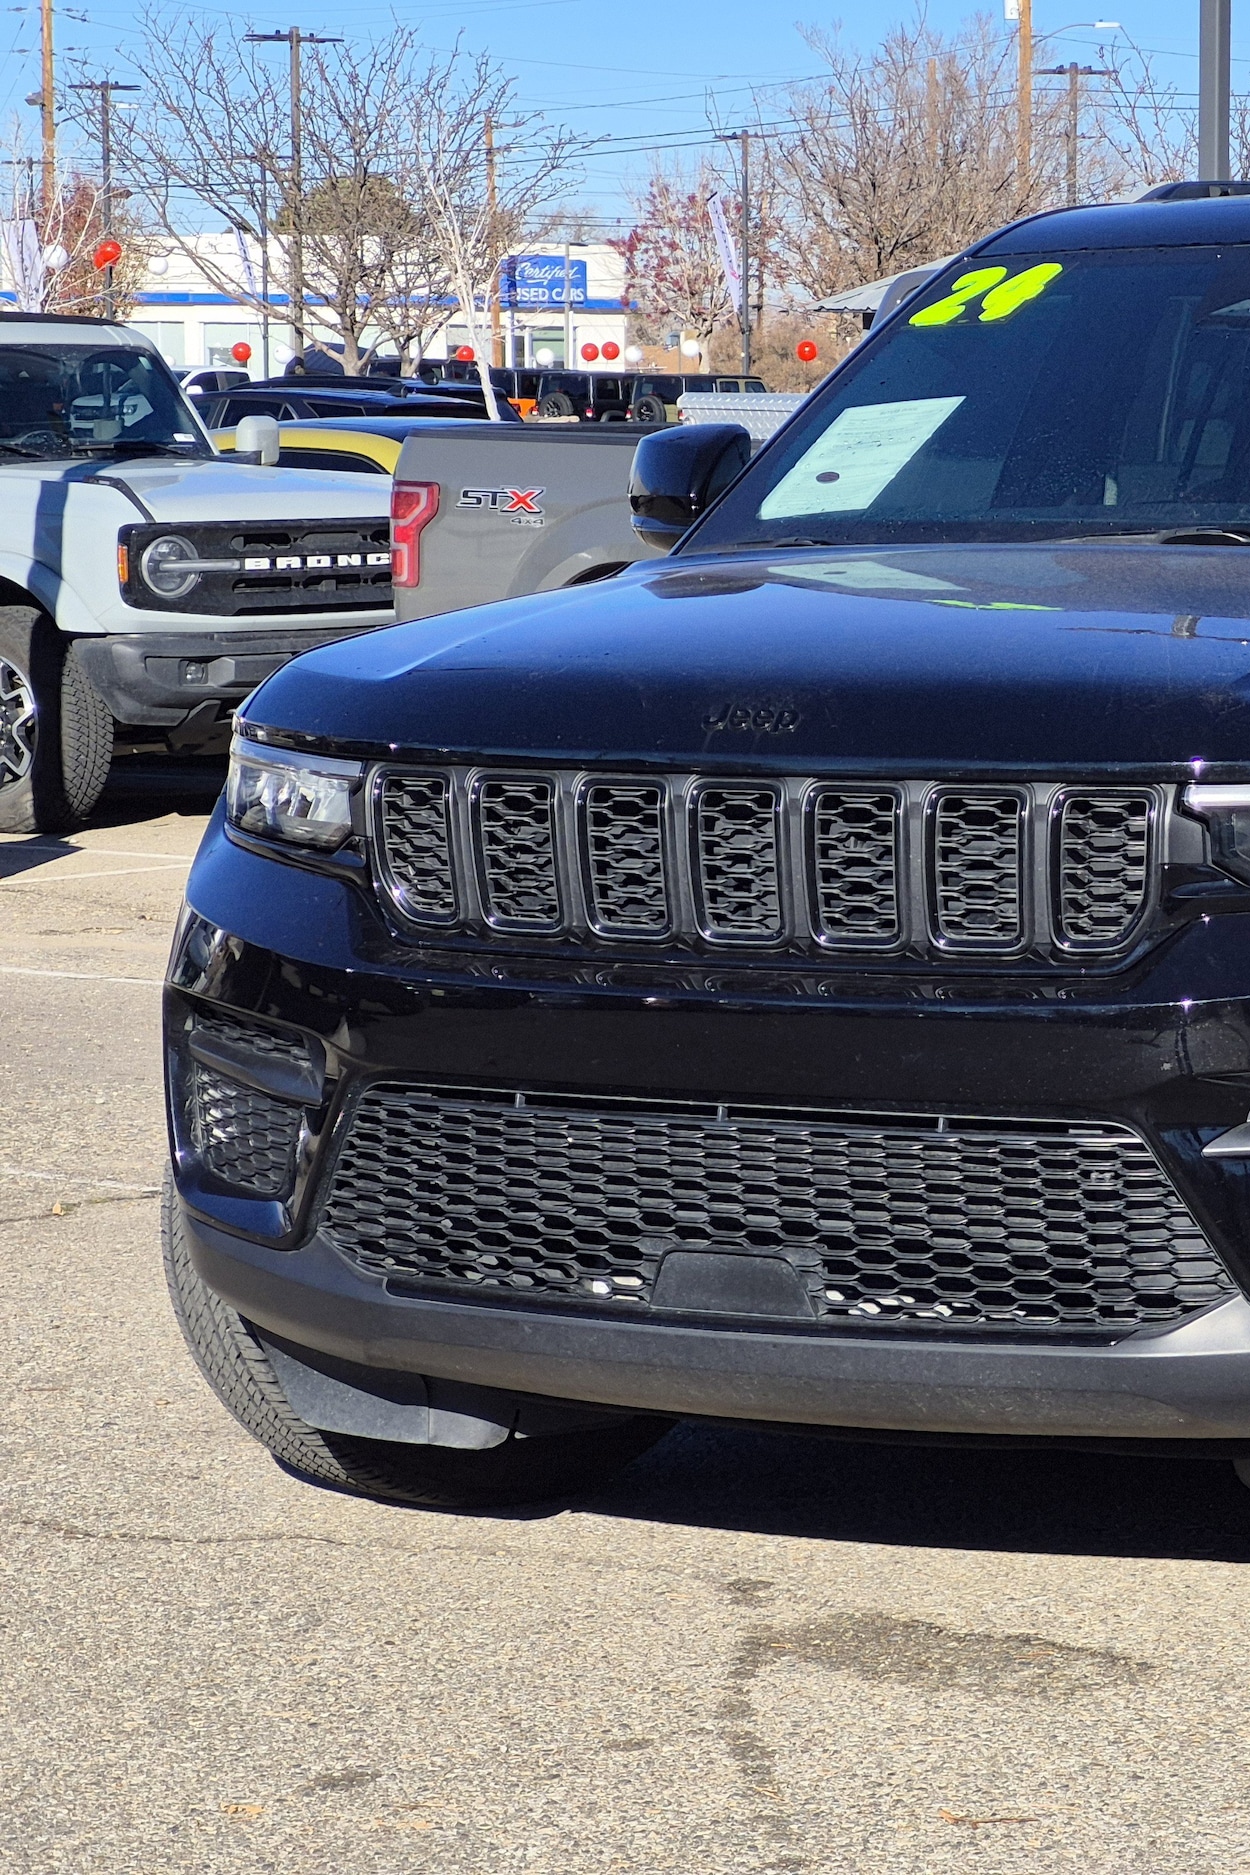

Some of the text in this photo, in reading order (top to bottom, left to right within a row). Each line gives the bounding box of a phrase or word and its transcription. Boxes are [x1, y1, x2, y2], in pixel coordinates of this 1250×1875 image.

[515, 262, 581, 285] Certified
[908, 262, 1063, 327] 24
[456, 486, 545, 514] STX
[244, 553, 392, 571] BRONC
[701, 700, 800, 735] Jeep
